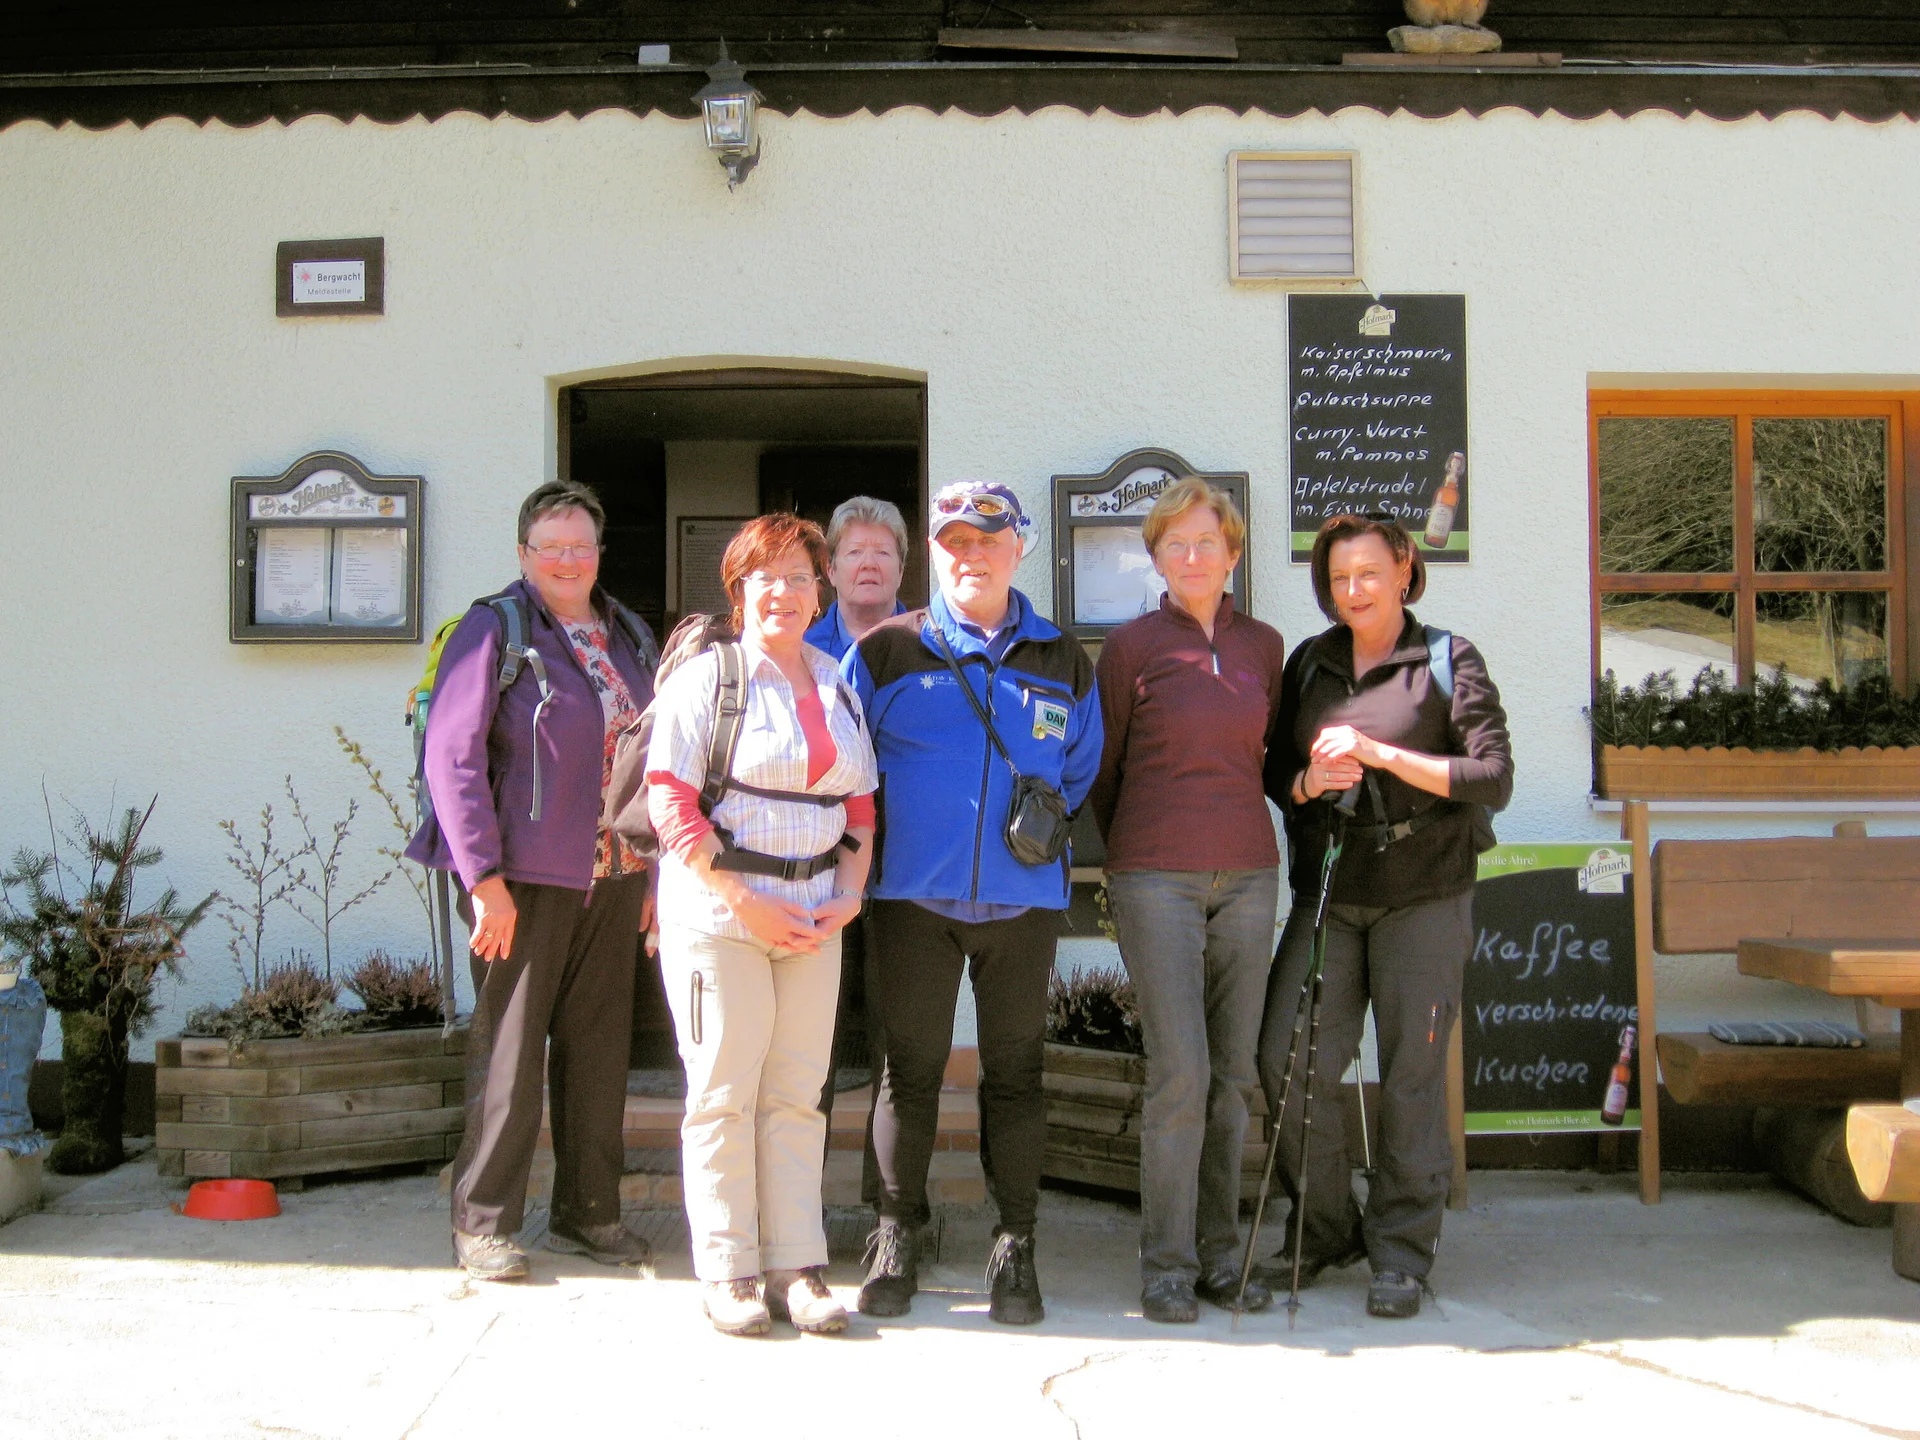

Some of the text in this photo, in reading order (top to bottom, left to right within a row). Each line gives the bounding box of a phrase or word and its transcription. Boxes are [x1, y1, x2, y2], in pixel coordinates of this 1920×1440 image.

[317, 272, 361, 283] Bergwacht
[1359, 312, 1394, 329] Hofmark
[1324, 362, 1411, 384] Apfelmus
[290, 475, 356, 516] Hofmark
[1110, 472, 1174, 513] Hofmark
[1294, 472, 1428, 500] Apfelstrudel
[1046, 711, 1067, 727] DAV
[1579, 857, 1628, 885] Hofmark
[1472, 922, 1611, 980] Kaffee
[1473, 1055, 1590, 1090] Kuchen
